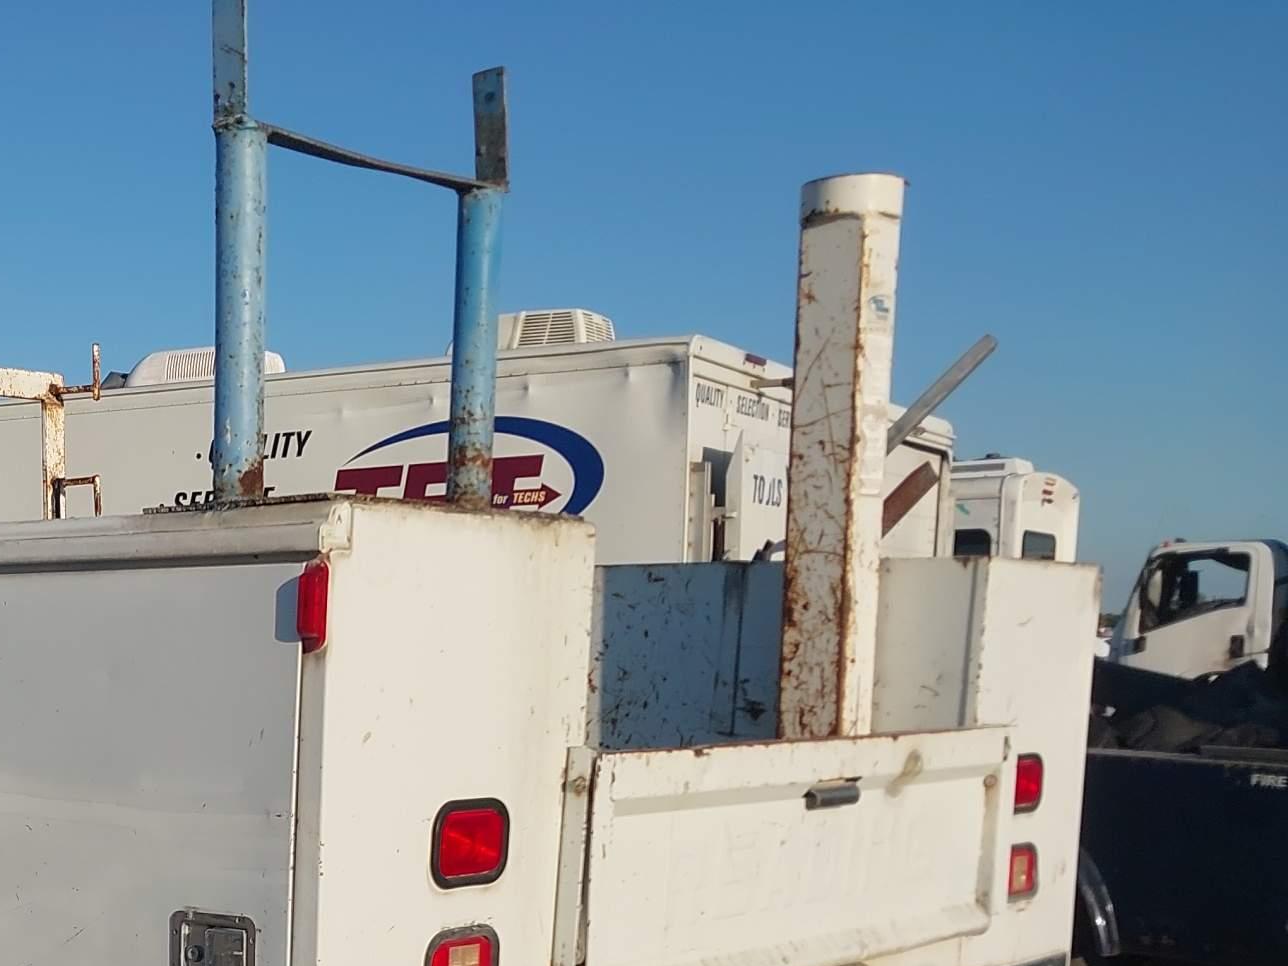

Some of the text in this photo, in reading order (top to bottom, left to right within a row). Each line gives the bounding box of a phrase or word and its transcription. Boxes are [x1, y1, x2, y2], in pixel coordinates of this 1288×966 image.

[695, 382, 725, 408] QUALITY
[736, 394, 770, 422] SELECTION
[492, 491, 546, 505] for TECHS
